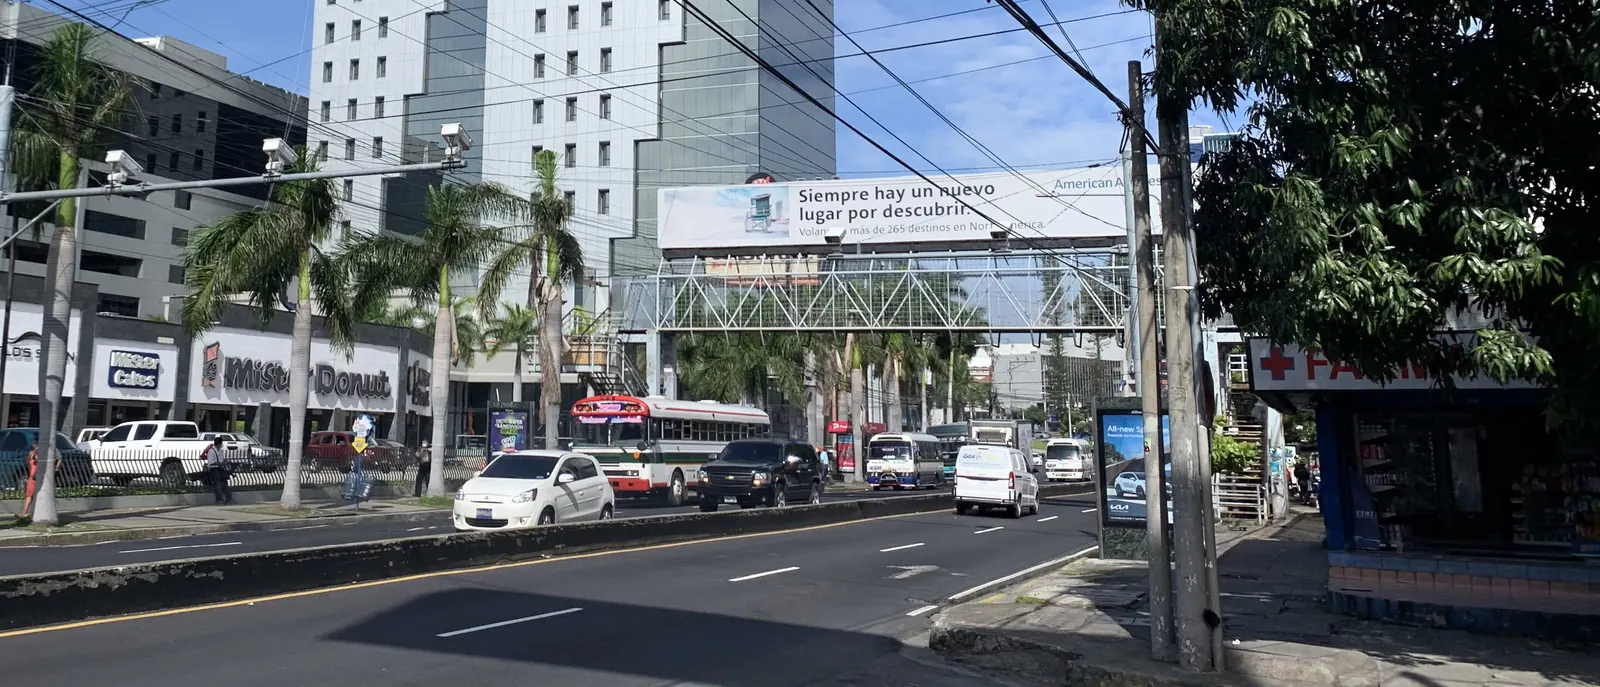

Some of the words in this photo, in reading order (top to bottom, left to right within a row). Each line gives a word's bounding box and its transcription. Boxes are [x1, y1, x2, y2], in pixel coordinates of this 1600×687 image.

[1054, 178, 1112, 190] American
[799, 188, 869, 205] Siempre
[875, 186, 905, 203] hay
[911, 186, 933, 198] un
[939, 182, 995, 197] nuevo
[799, 207, 843, 225] lugar
[848, 208, 878, 223] por
[882, 201, 970, 218] descubrir.
[850, 225, 870, 235] más
[872, 225, 885, 235] de
[887, 224, 905, 234] 265
[907, 222, 951, 235] destinos
[110, 351, 159, 369] Mister
[113, 370, 155, 387] Cakes
[315, 363, 391, 399] Donut
[1107, 425, 1135, 433] All-new
